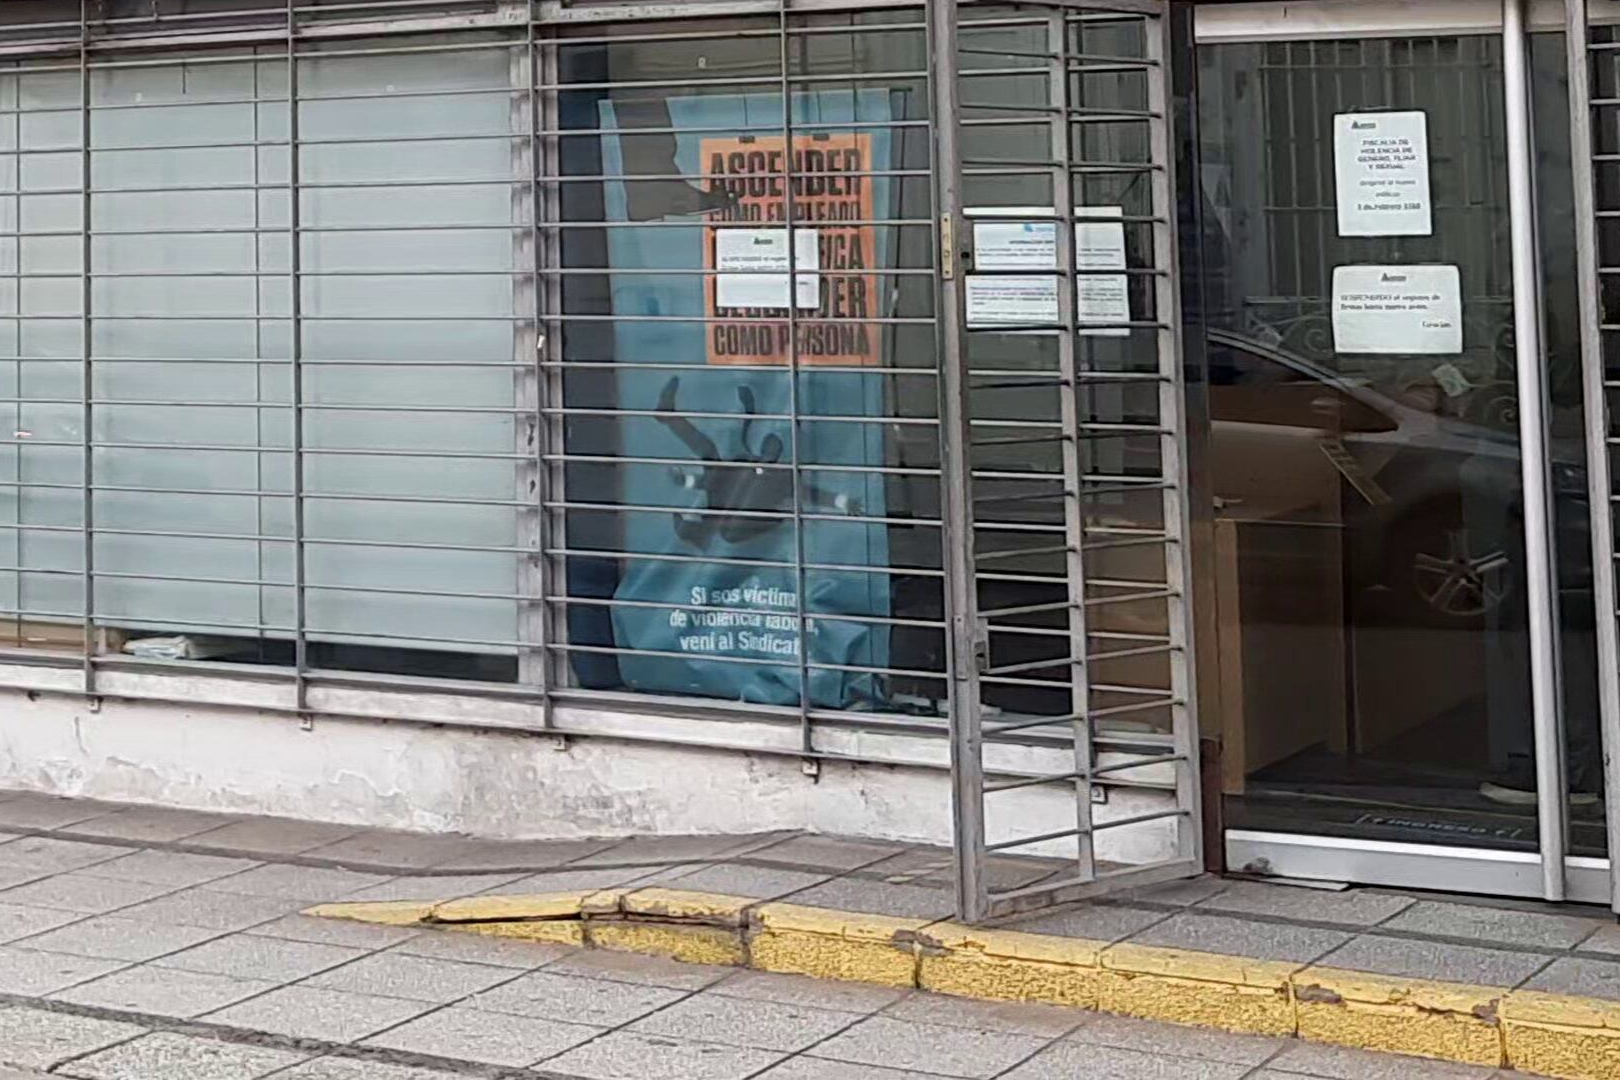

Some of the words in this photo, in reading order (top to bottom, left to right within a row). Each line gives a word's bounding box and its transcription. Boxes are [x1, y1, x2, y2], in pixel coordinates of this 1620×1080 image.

[710, 148, 863, 198] ASCENDER
[714, 324, 773, 357] COMO
[690, 586, 707, 605] Si
[670, 609, 687, 628] de
[718, 631, 733, 650] al
